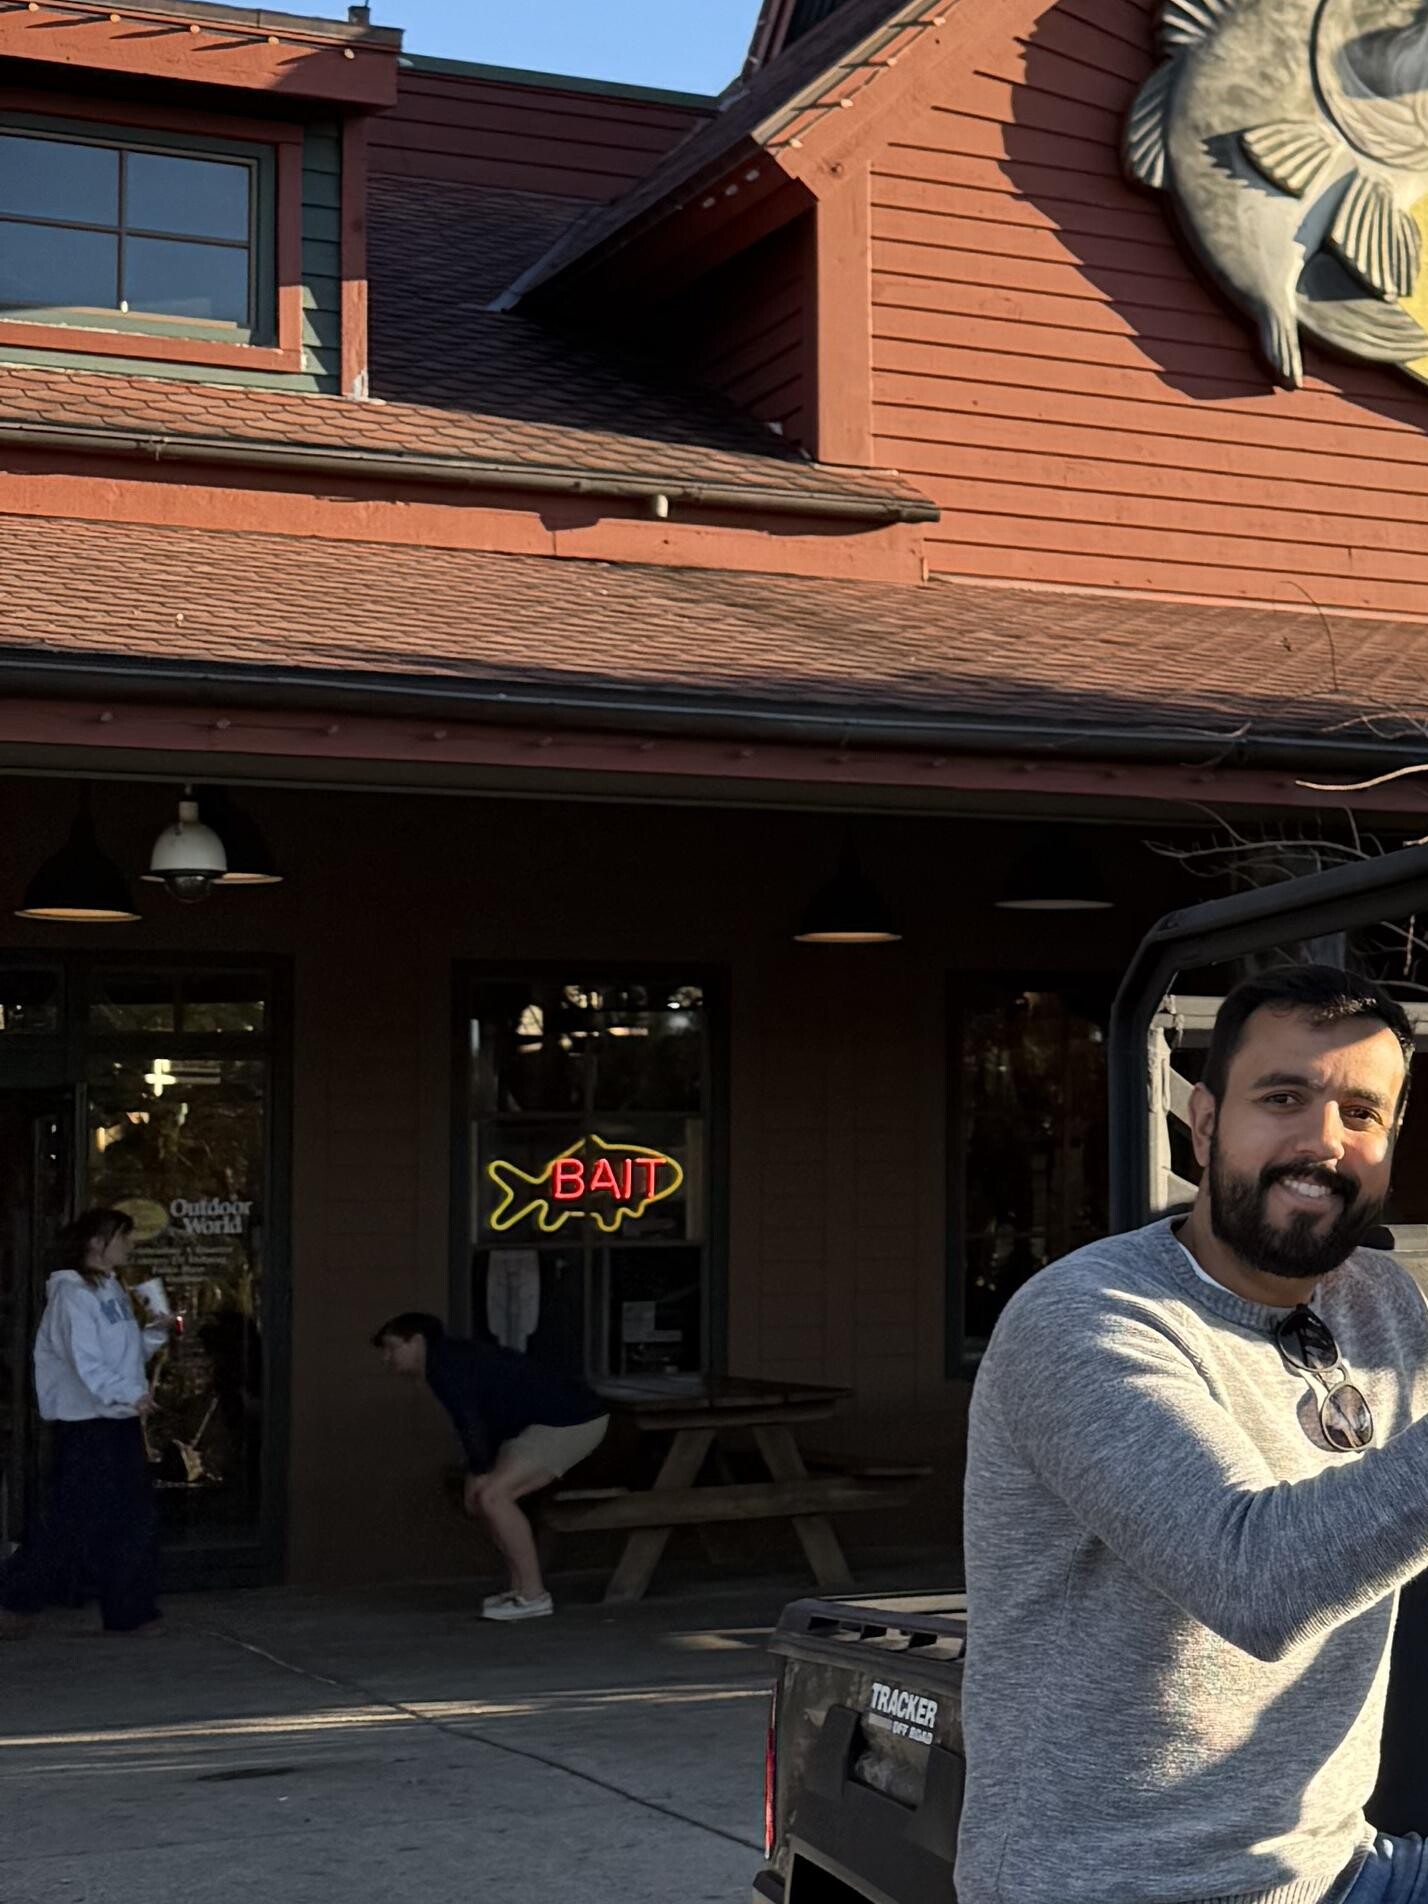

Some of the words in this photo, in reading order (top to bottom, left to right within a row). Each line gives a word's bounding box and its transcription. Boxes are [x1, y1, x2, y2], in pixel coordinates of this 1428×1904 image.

[554, 1157, 668, 1199] BAIT
[170, 1197, 253, 1217] Outdoor
[183, 1216, 243, 1235] World
[871, 1682, 938, 1728] TRACKER
